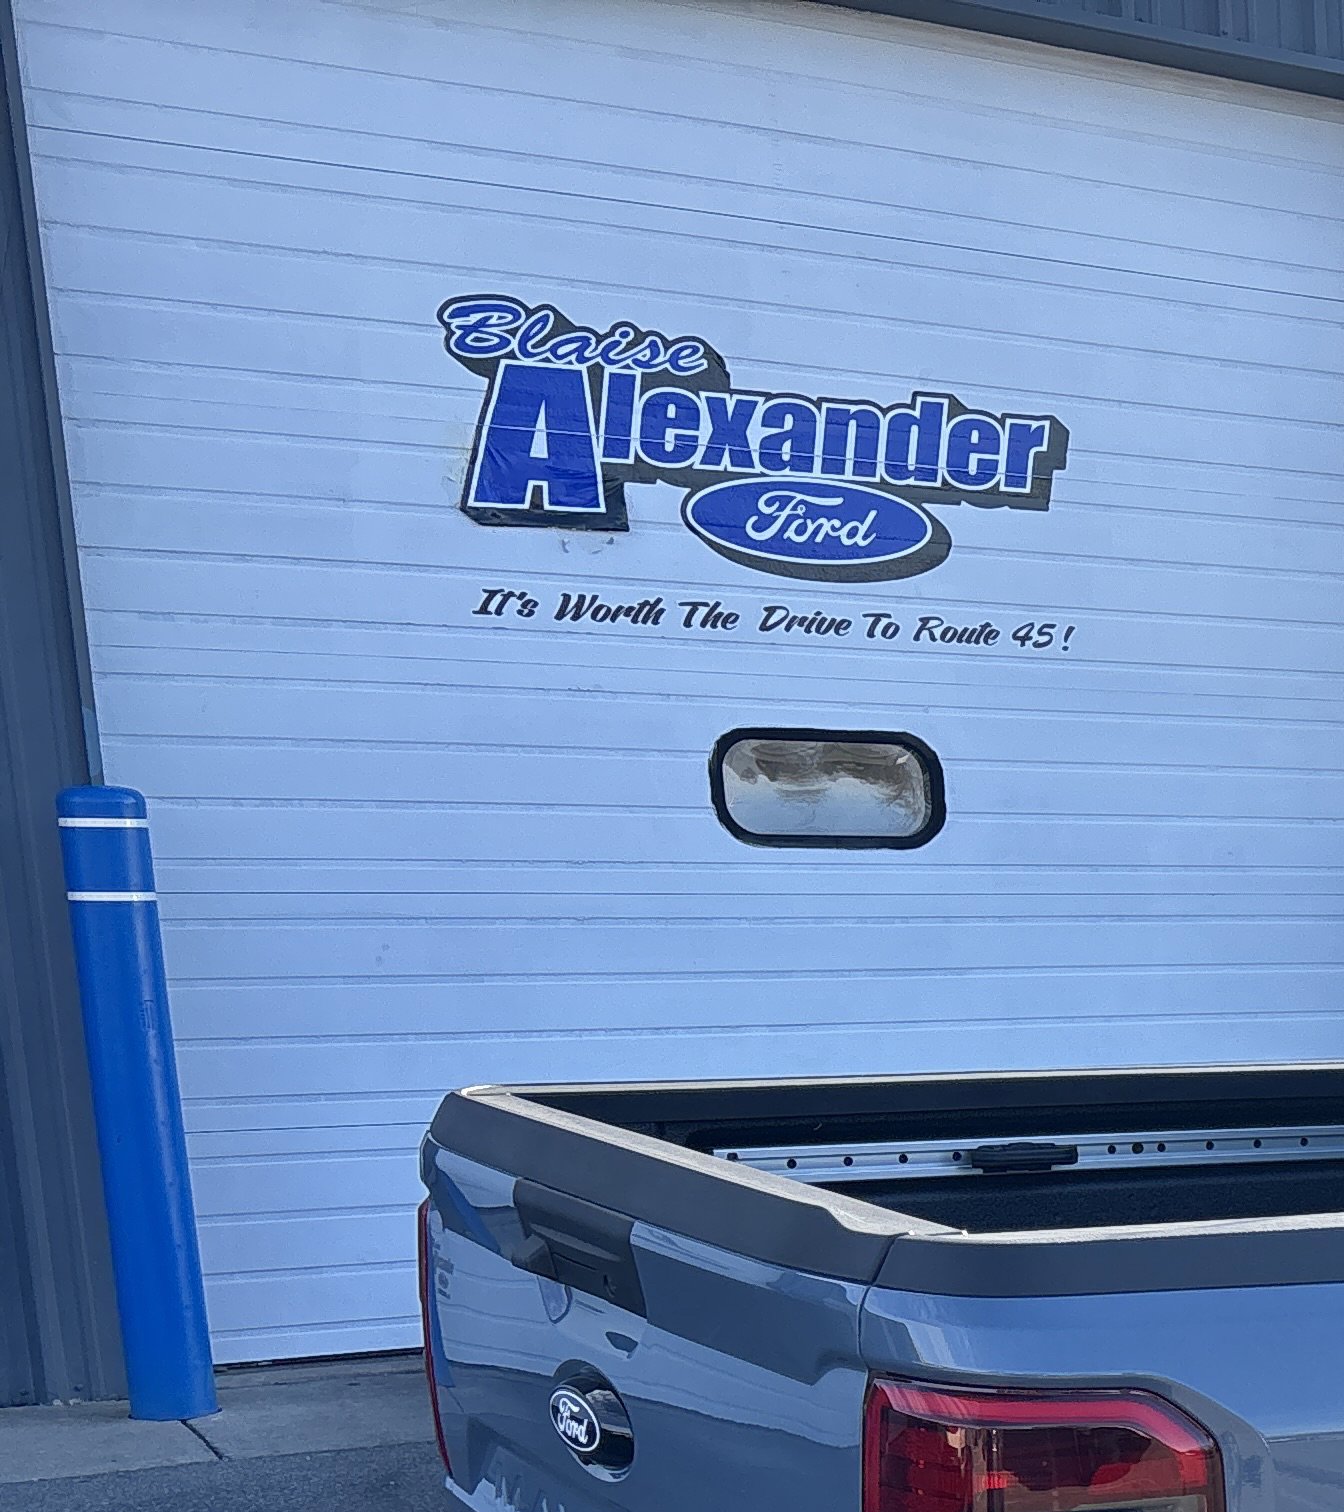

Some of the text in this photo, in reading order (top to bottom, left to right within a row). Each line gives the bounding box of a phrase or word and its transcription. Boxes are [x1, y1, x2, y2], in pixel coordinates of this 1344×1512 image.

[443, 299, 708, 375] Blaise
[465, 358, 1053, 513] Alexander
[743, 489, 879, 548] Ford
[472, 588, 540, 618] It's
[553, 592, 667, 626] Worth
[678, 600, 741, 631] The
[757, 605, 853, 636] Drive
[862, 612, 901, 640] To
[912, 616, 1001, 646] Route
[557, 1397, 589, 1445] Ford
